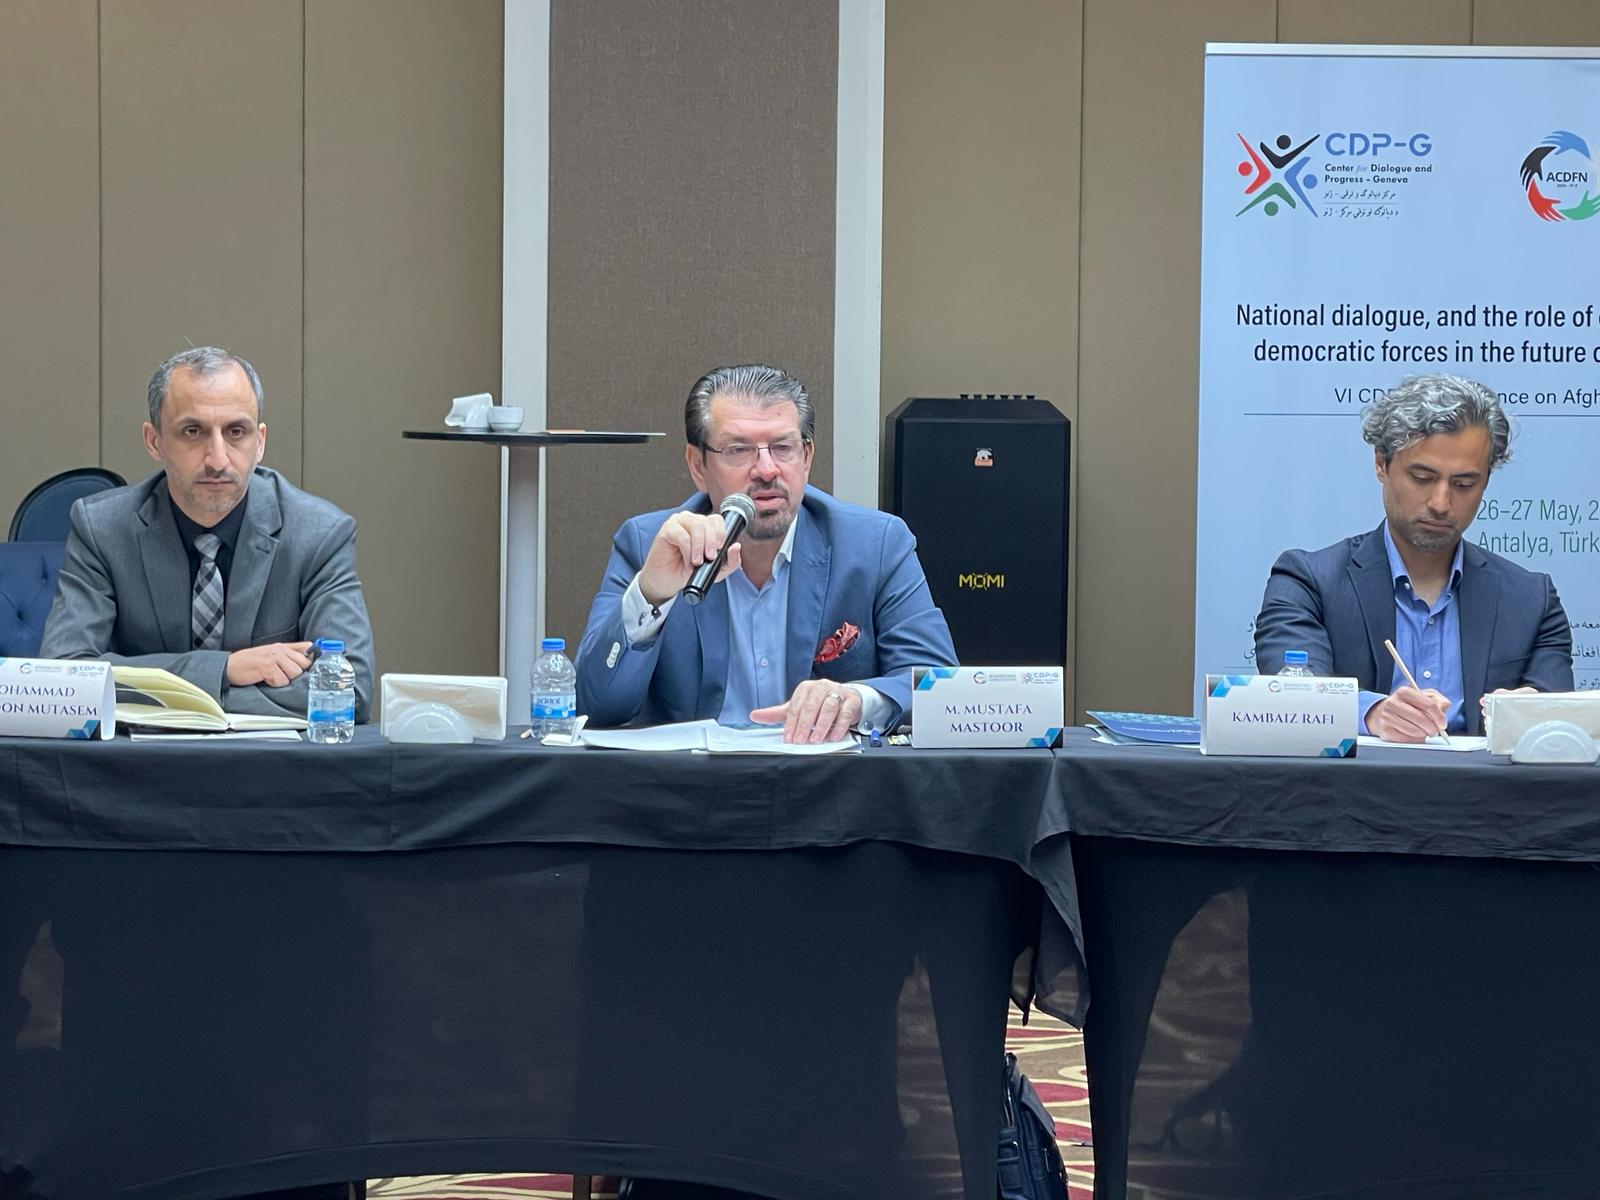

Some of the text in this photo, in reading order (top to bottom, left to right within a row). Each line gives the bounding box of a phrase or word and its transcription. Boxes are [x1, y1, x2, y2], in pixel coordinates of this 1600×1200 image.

[1325, 132, 1432, 156] CDP-G
[1325, 163, 1354, 172] Center
[1371, 163, 1412, 174] Dialogue
[1415, 164, 1432, 172] and
[1324, 174, 1364, 184] Progress
[1373, 175, 1408, 183] Geneva
[1546, 171, 1588, 182] ACDFN
[1236, 303, 1325, 326] National
[1332, 303, 1430, 332] dialogue,
[1437, 304, 1477, 327] and
[1483, 304, 1518, 327] the
[1525, 304, 1566, 328] role
[1572, 305, 1594, 328] of
[1254, 338, 1375, 362] democratic
[1381, 339, 1448, 362] forces
[1455, 340, 1474, 363] in
[1480, 340, 1515, 363] the
[1521, 340, 1587, 363] future
[1334, 388, 1352, 403] VI
[1535, 392, 1556, 404] on
[1540, 499, 1582, 526] May,
[1479, 530, 1600, 558] Antalya, Türk
[959, 573, 1005, 590] MOMI
[0, 702, 98, 716] ON MUTASEM
[945, 704, 1032, 715] M. MUSTAFA
[1232, 711, 1334, 725] KAMBAIZ RAFI
[950, 722, 1024, 733] MASTOOR
